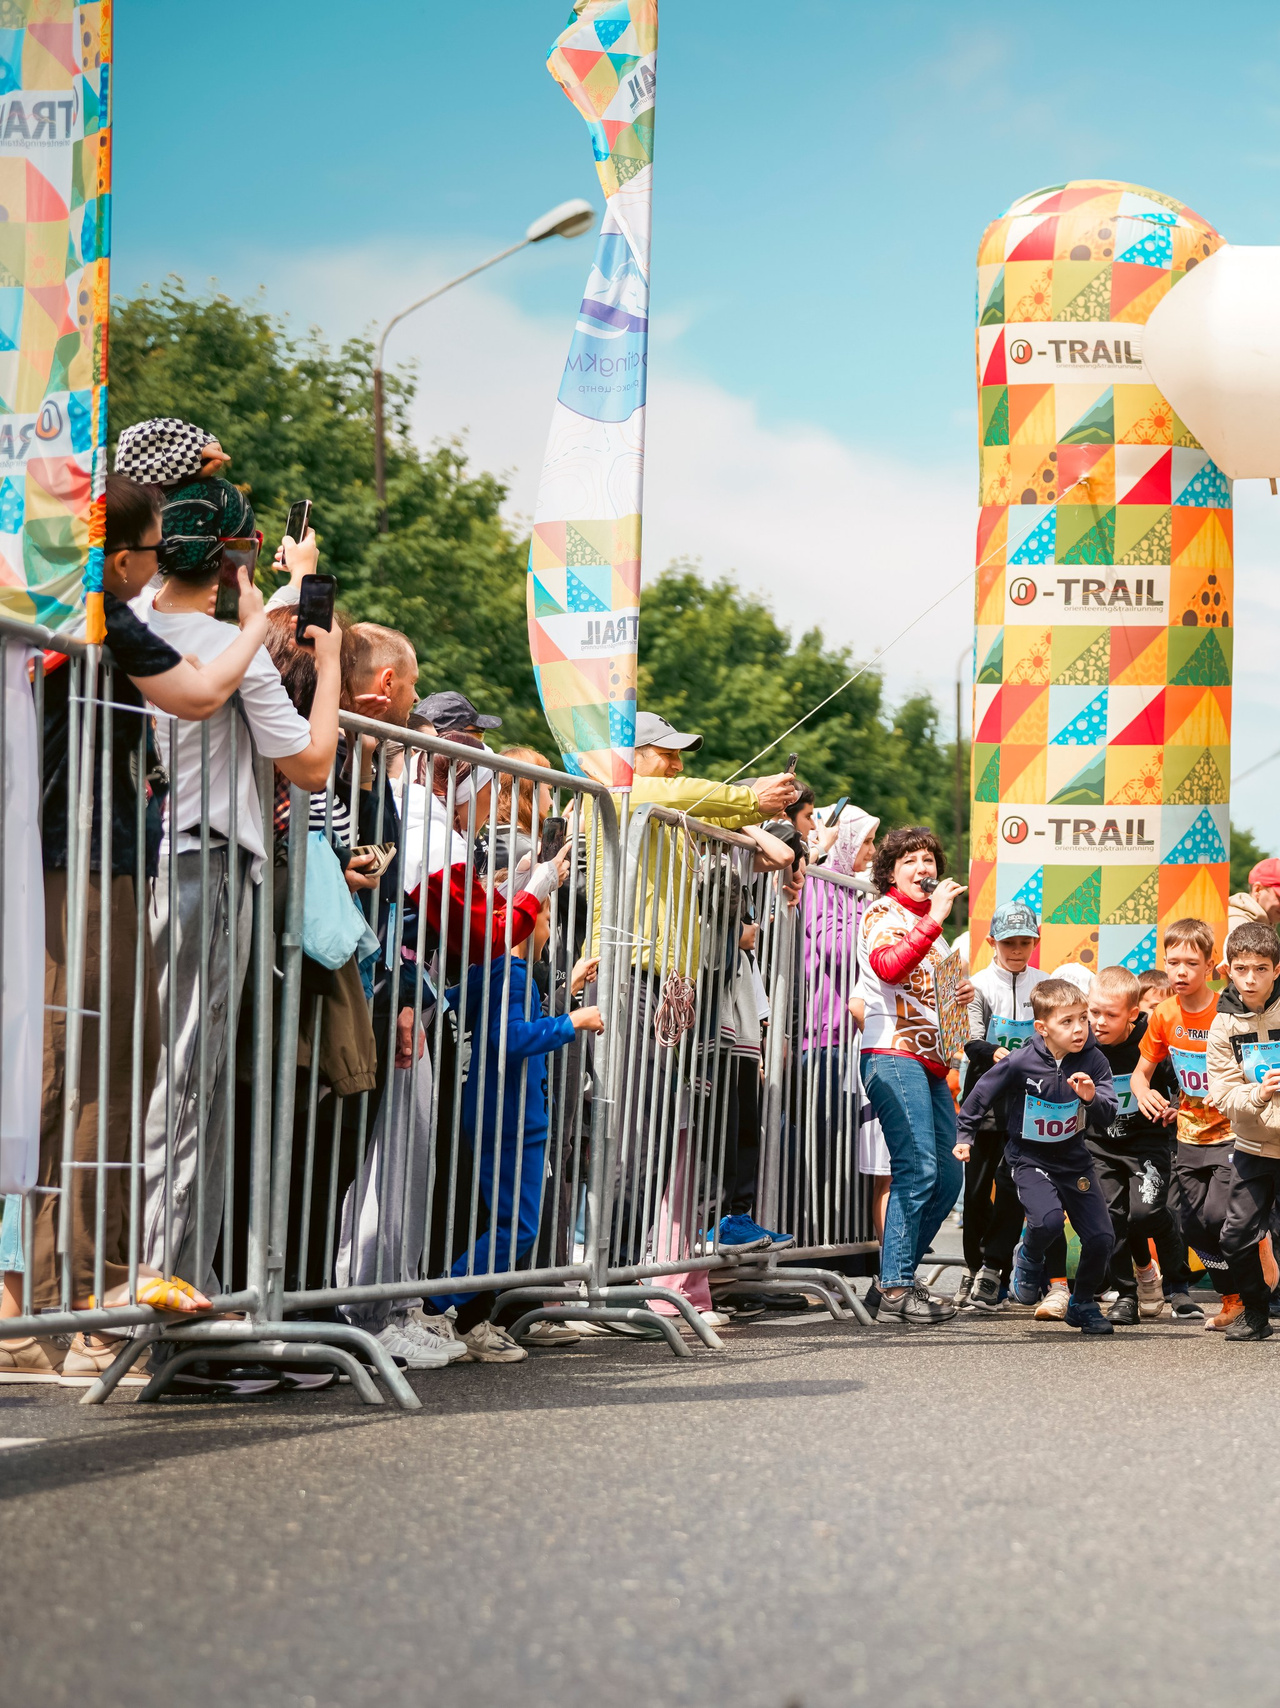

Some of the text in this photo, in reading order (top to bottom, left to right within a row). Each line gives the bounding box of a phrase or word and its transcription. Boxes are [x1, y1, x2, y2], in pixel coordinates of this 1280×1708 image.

[1064, 605, 1164, 613] orienteering&trailrunning
[1054, 845, 1155, 853] orienteering&trailrunning
[1034, 1115, 1078, 1137] 102
